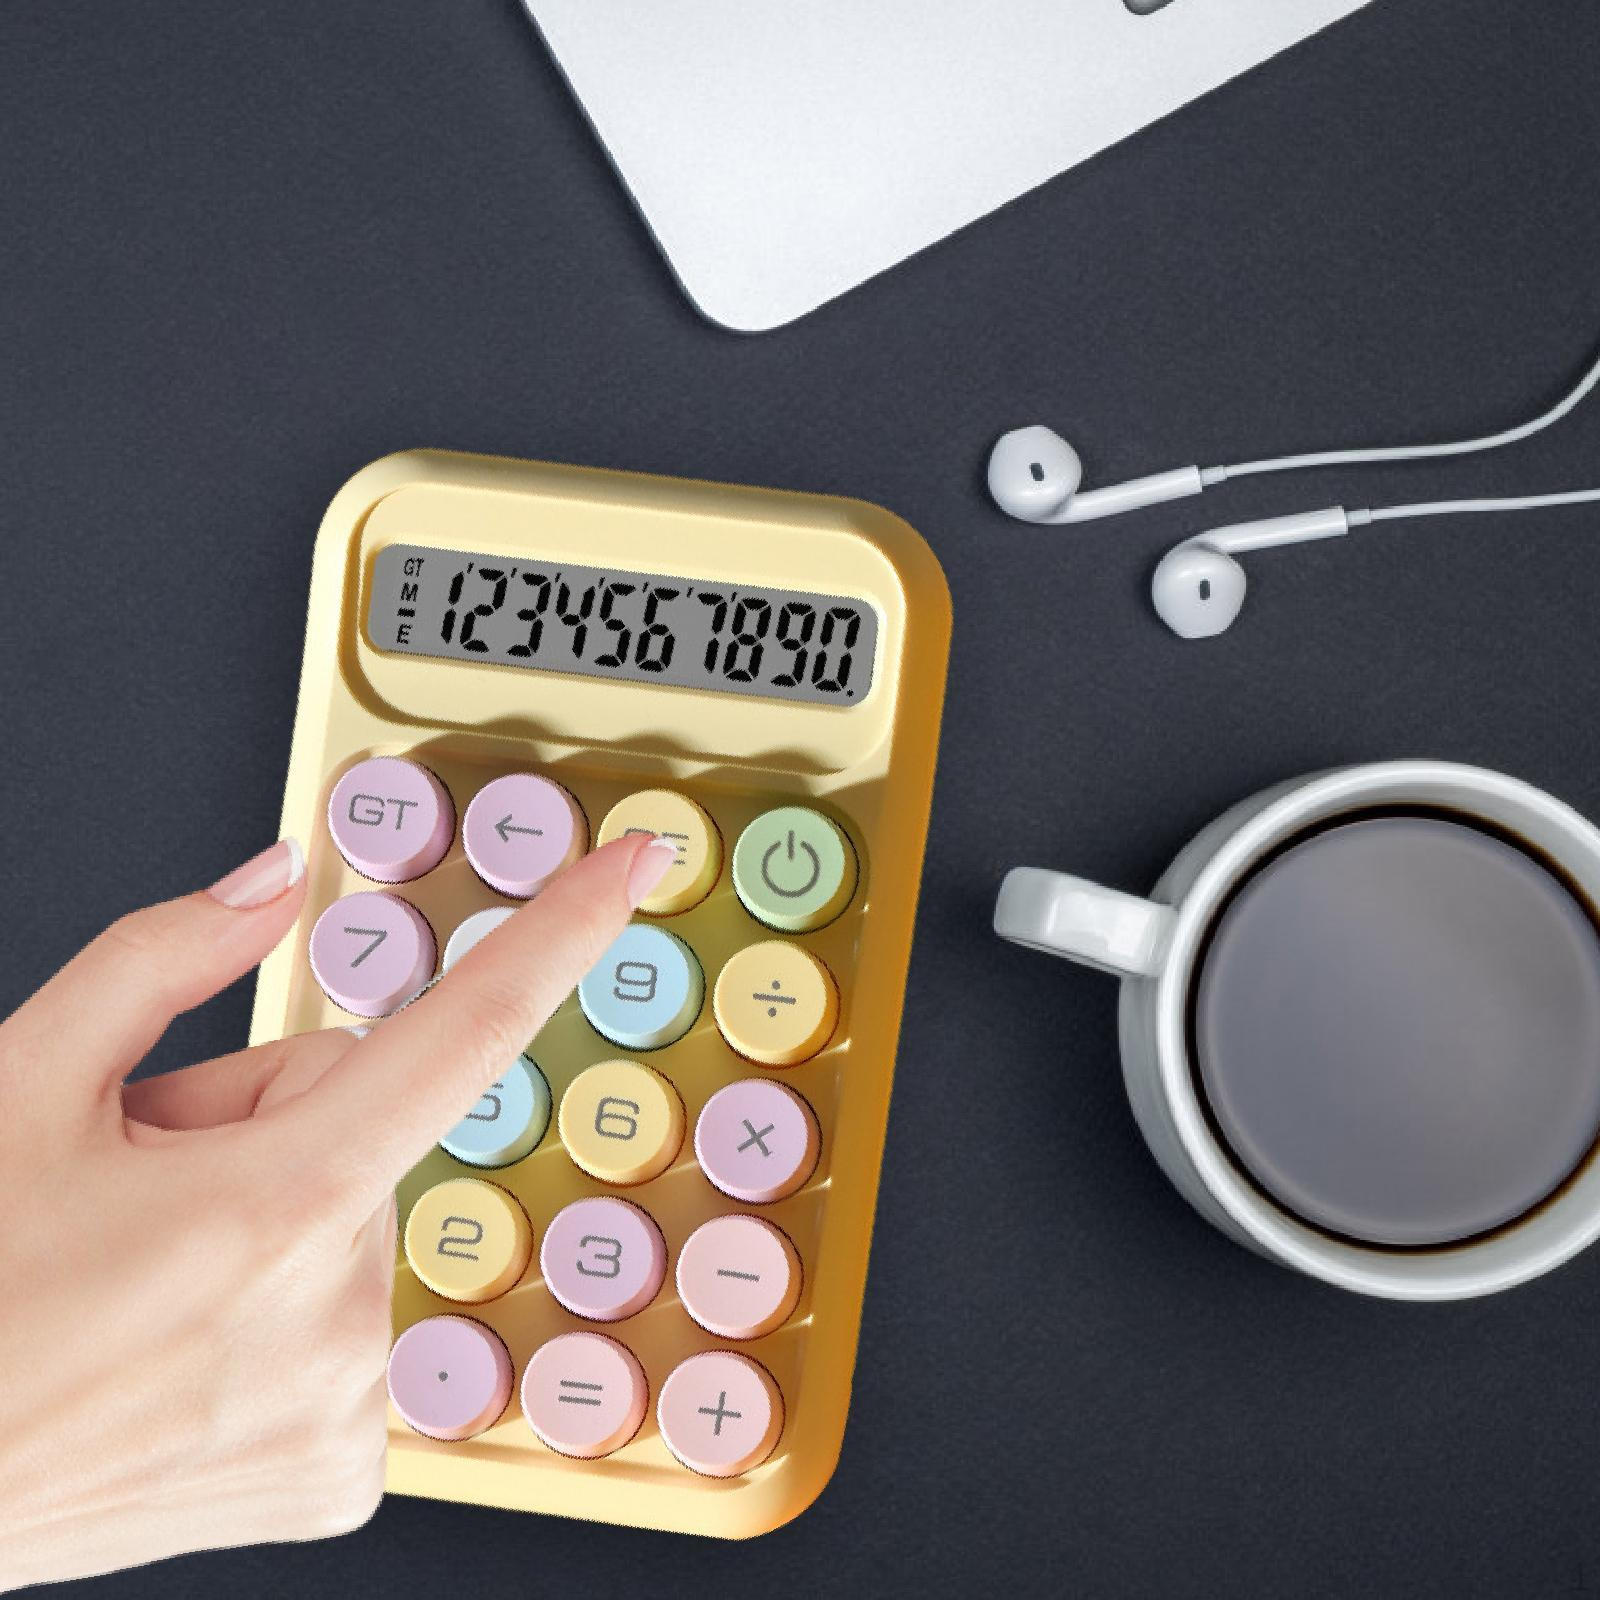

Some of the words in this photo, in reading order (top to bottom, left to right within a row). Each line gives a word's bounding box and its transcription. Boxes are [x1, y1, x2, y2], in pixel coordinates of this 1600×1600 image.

[404, 557, 425, 577] GT
[400, 581, 419, 602] M
[396, 623, 413, 644] E
[348, 793, 419, 831] GT
[343, 926, 388, 969] 7
[612, 960, 658, 1004] 9
[594, 1095, 641, 1142] 6
[436, 1215, 484, 1262] 2
[575, 1234, 623, 1280] 3
